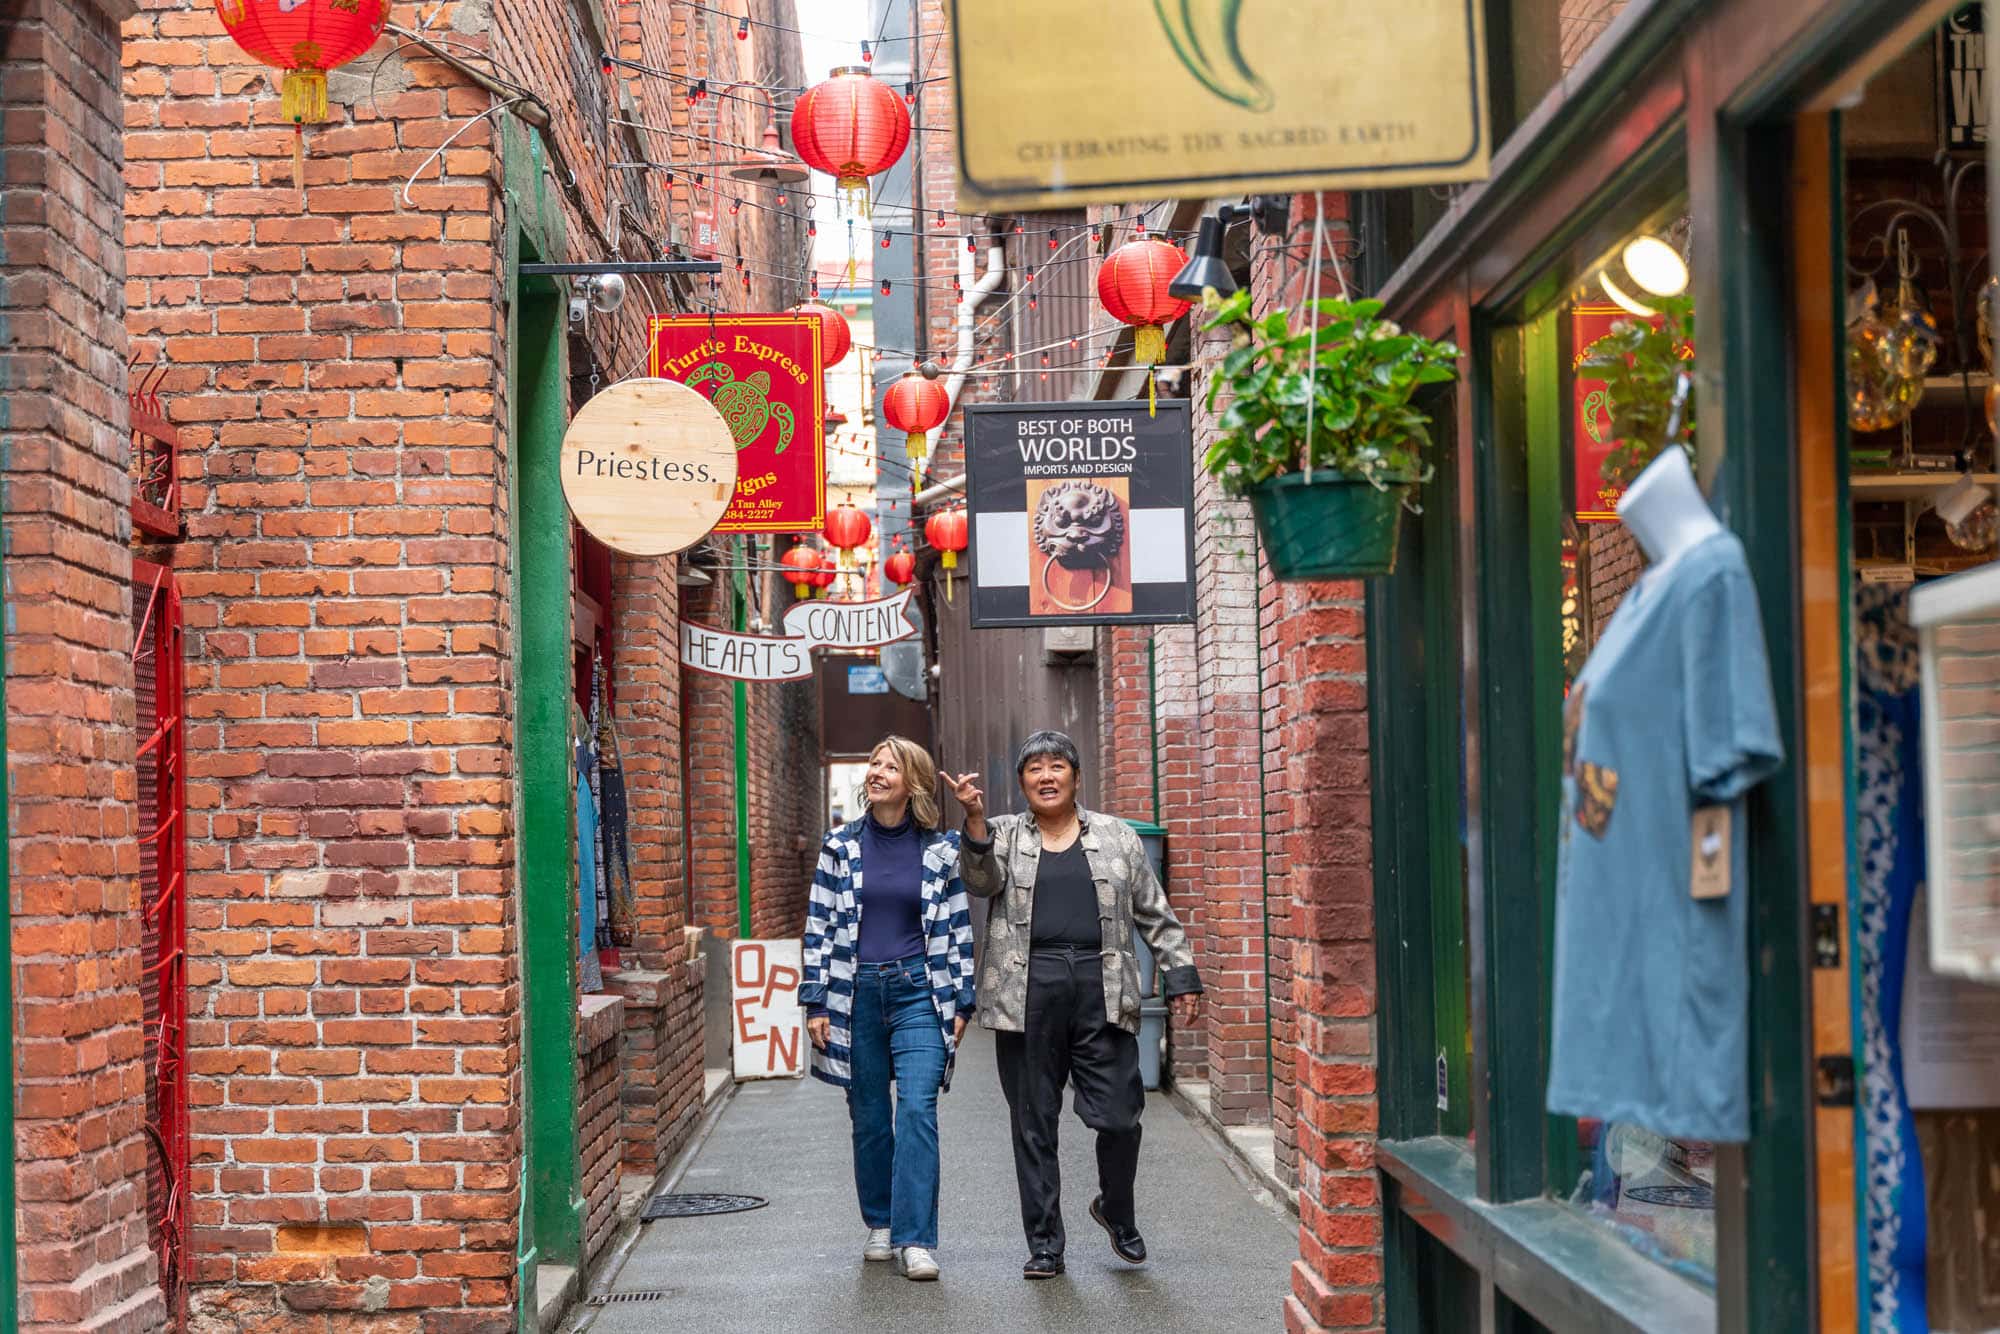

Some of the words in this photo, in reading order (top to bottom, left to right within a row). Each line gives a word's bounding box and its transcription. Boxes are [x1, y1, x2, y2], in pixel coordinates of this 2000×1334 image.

[1238, 125, 1328, 148] SACRED
[663, 338, 727, 377] Turtle
[733, 335, 809, 385] Express
[1018, 419, 1057, 436] BEST
[1060, 419, 1083, 434] OF
[1087, 418, 1133, 434] BOTH
[1018, 436, 1137, 462] WORLDS
[577, 450, 717, 483] Priestess.
[1024, 464, 1068, 475] IMPORTS
[1070, 463, 1093, 474] AND
[1095, 463, 1133, 473] DESIGN
[736, 471, 777, 496] igns
[736, 499, 755, 509] Tan
[758, 499, 783, 510] Alley
[688, 628, 801, 677] HEART'S
[808, 602, 902, 643] CONTENT
